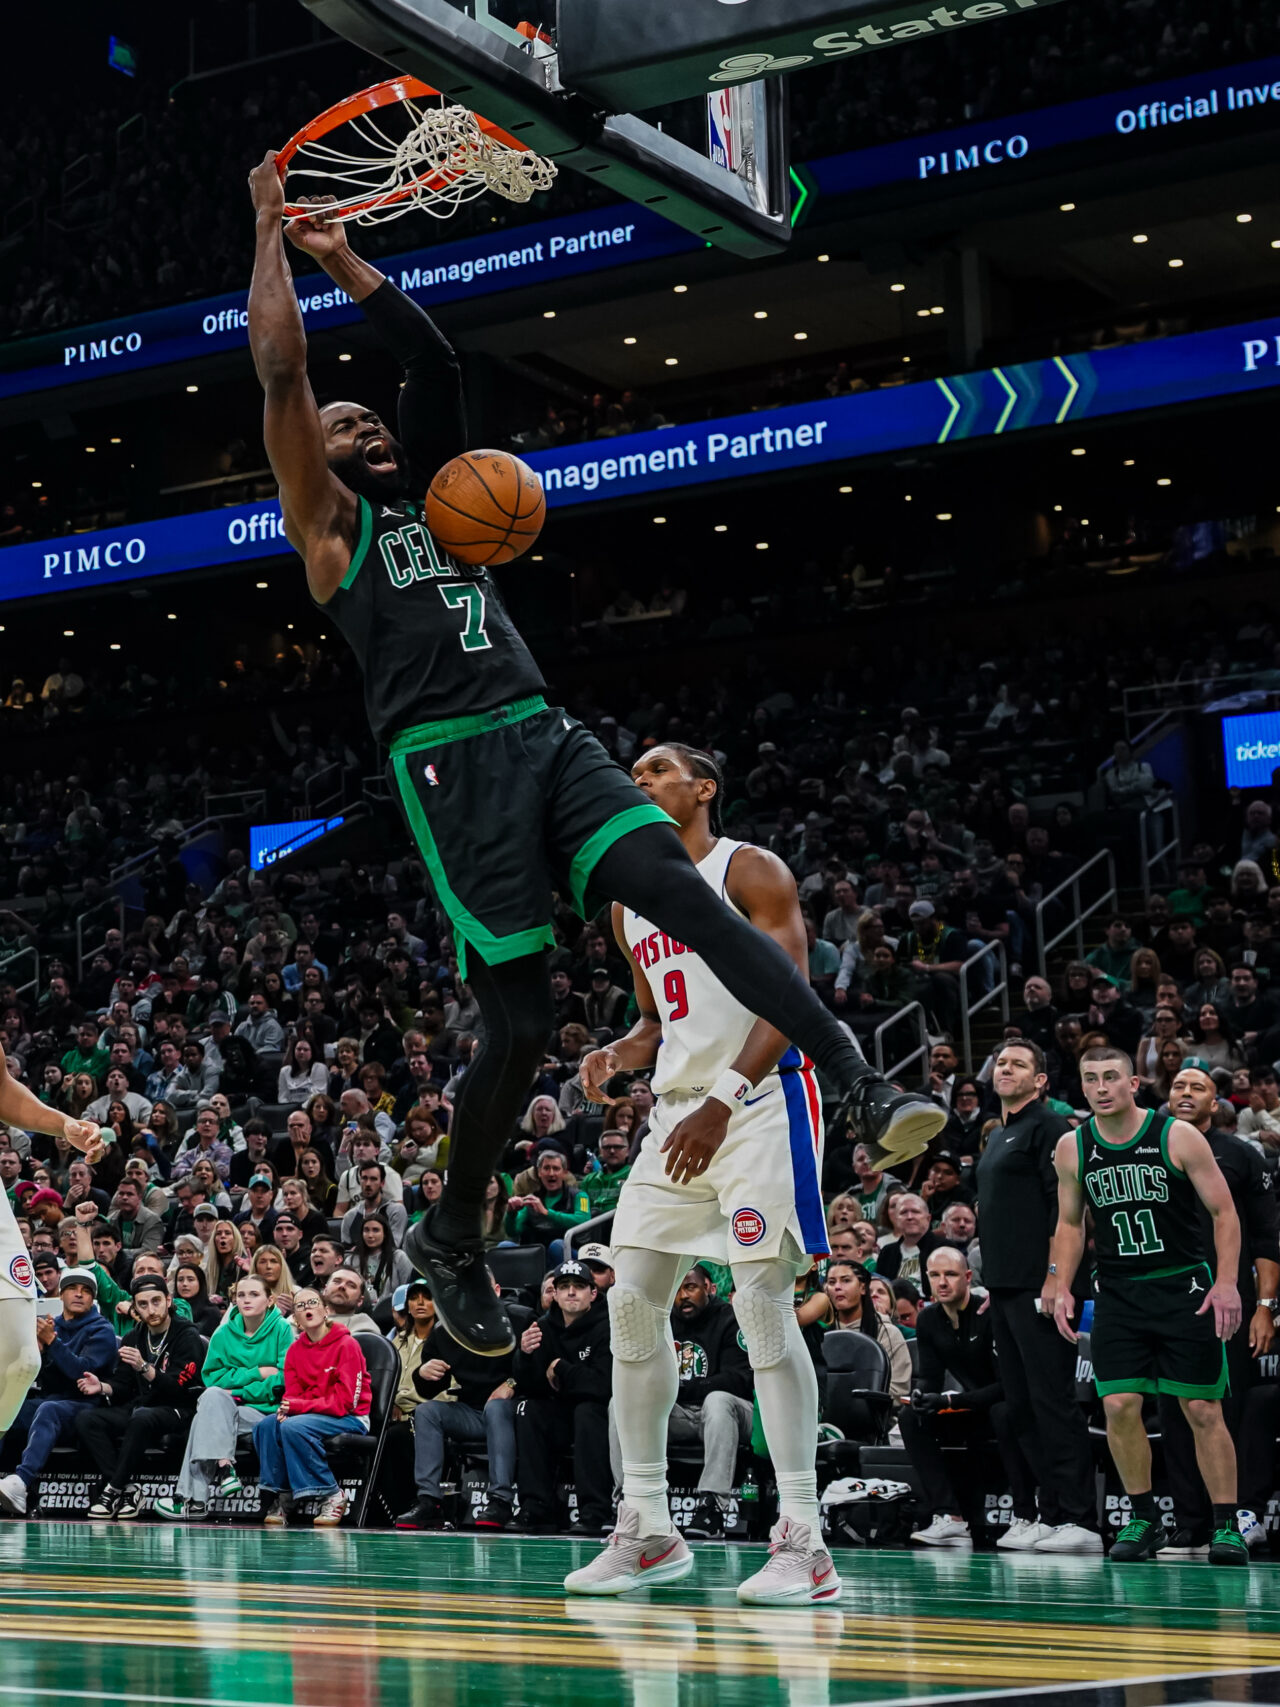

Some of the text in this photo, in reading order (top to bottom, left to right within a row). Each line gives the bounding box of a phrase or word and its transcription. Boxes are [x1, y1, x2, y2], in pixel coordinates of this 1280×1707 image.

[812, 1, 1008, 57] State
[1115, 90, 1218, 133] Official
[918, 134, 1029, 179] PIMCO
[202, 308, 249, 335] Offic
[401, 242, 543, 291] Management
[551, 224, 635, 260] Partner
[64, 332, 142, 366] PIMCO
[535, 441, 697, 491] nagement
[708, 421, 827, 462] Partner
[43, 538, 146, 579] PIMCO
[437, 582, 492, 652] 7
[664, 969, 689, 1023] 9
[1085, 1164, 1169, 1208] CELTICS
[1112, 1209, 1165, 1256] 11
[39, 1495, 91, 1508] CELTICS
[208, 1499, 261, 1512] CELTICS
